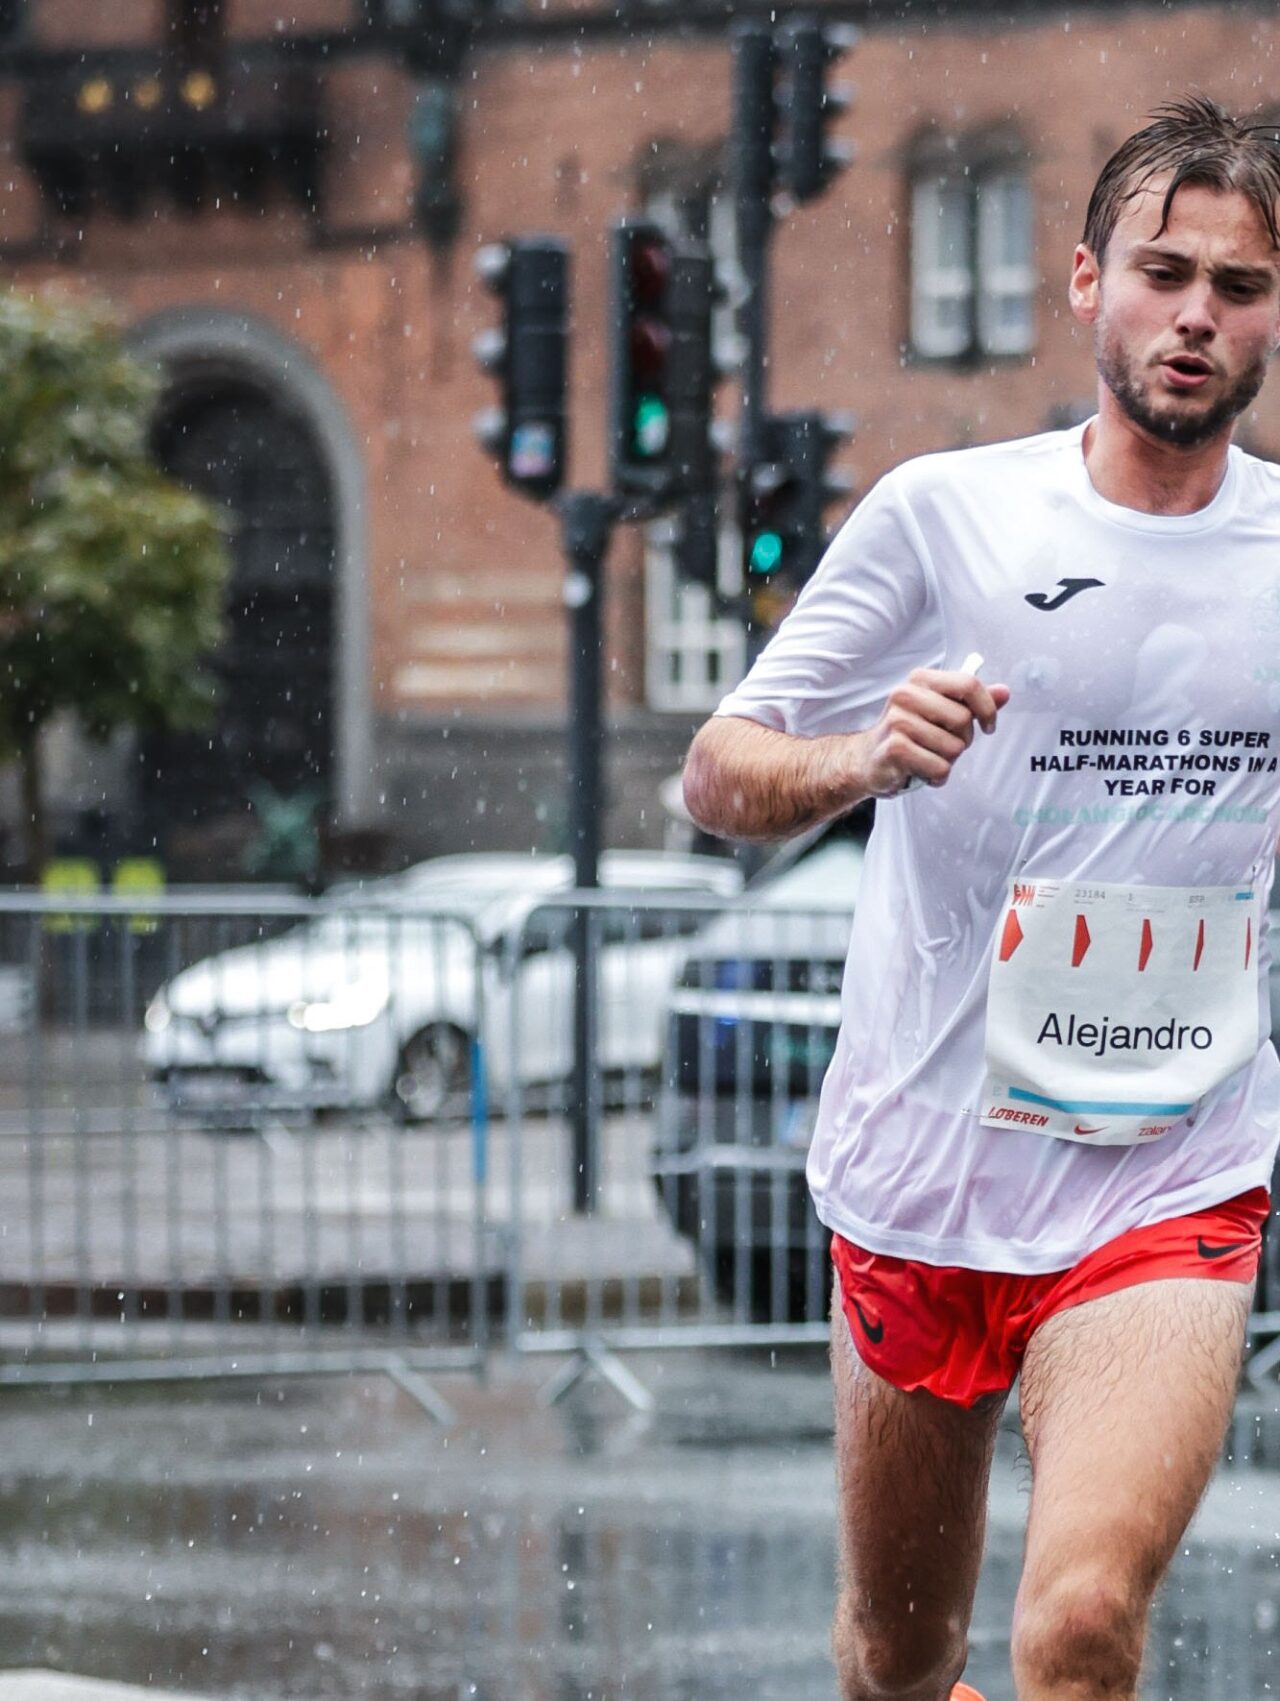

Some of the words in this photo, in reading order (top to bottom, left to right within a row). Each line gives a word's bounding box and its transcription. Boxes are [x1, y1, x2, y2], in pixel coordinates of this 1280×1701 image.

[1059, 729, 1169, 747] RUNNING
[1177, 731, 1190, 746] 6
[1199, 730, 1271, 749] SUPER
[1030, 755, 1240, 772] HALF-MARATHONS
[1247, 757, 1265, 772] IN
[1267, 757, 1277, 772] A
[1105, 779, 1164, 796] YEAR
[1170, 778, 1216, 796] FOR
[1036, 1012, 1213, 1056] Alejandro
